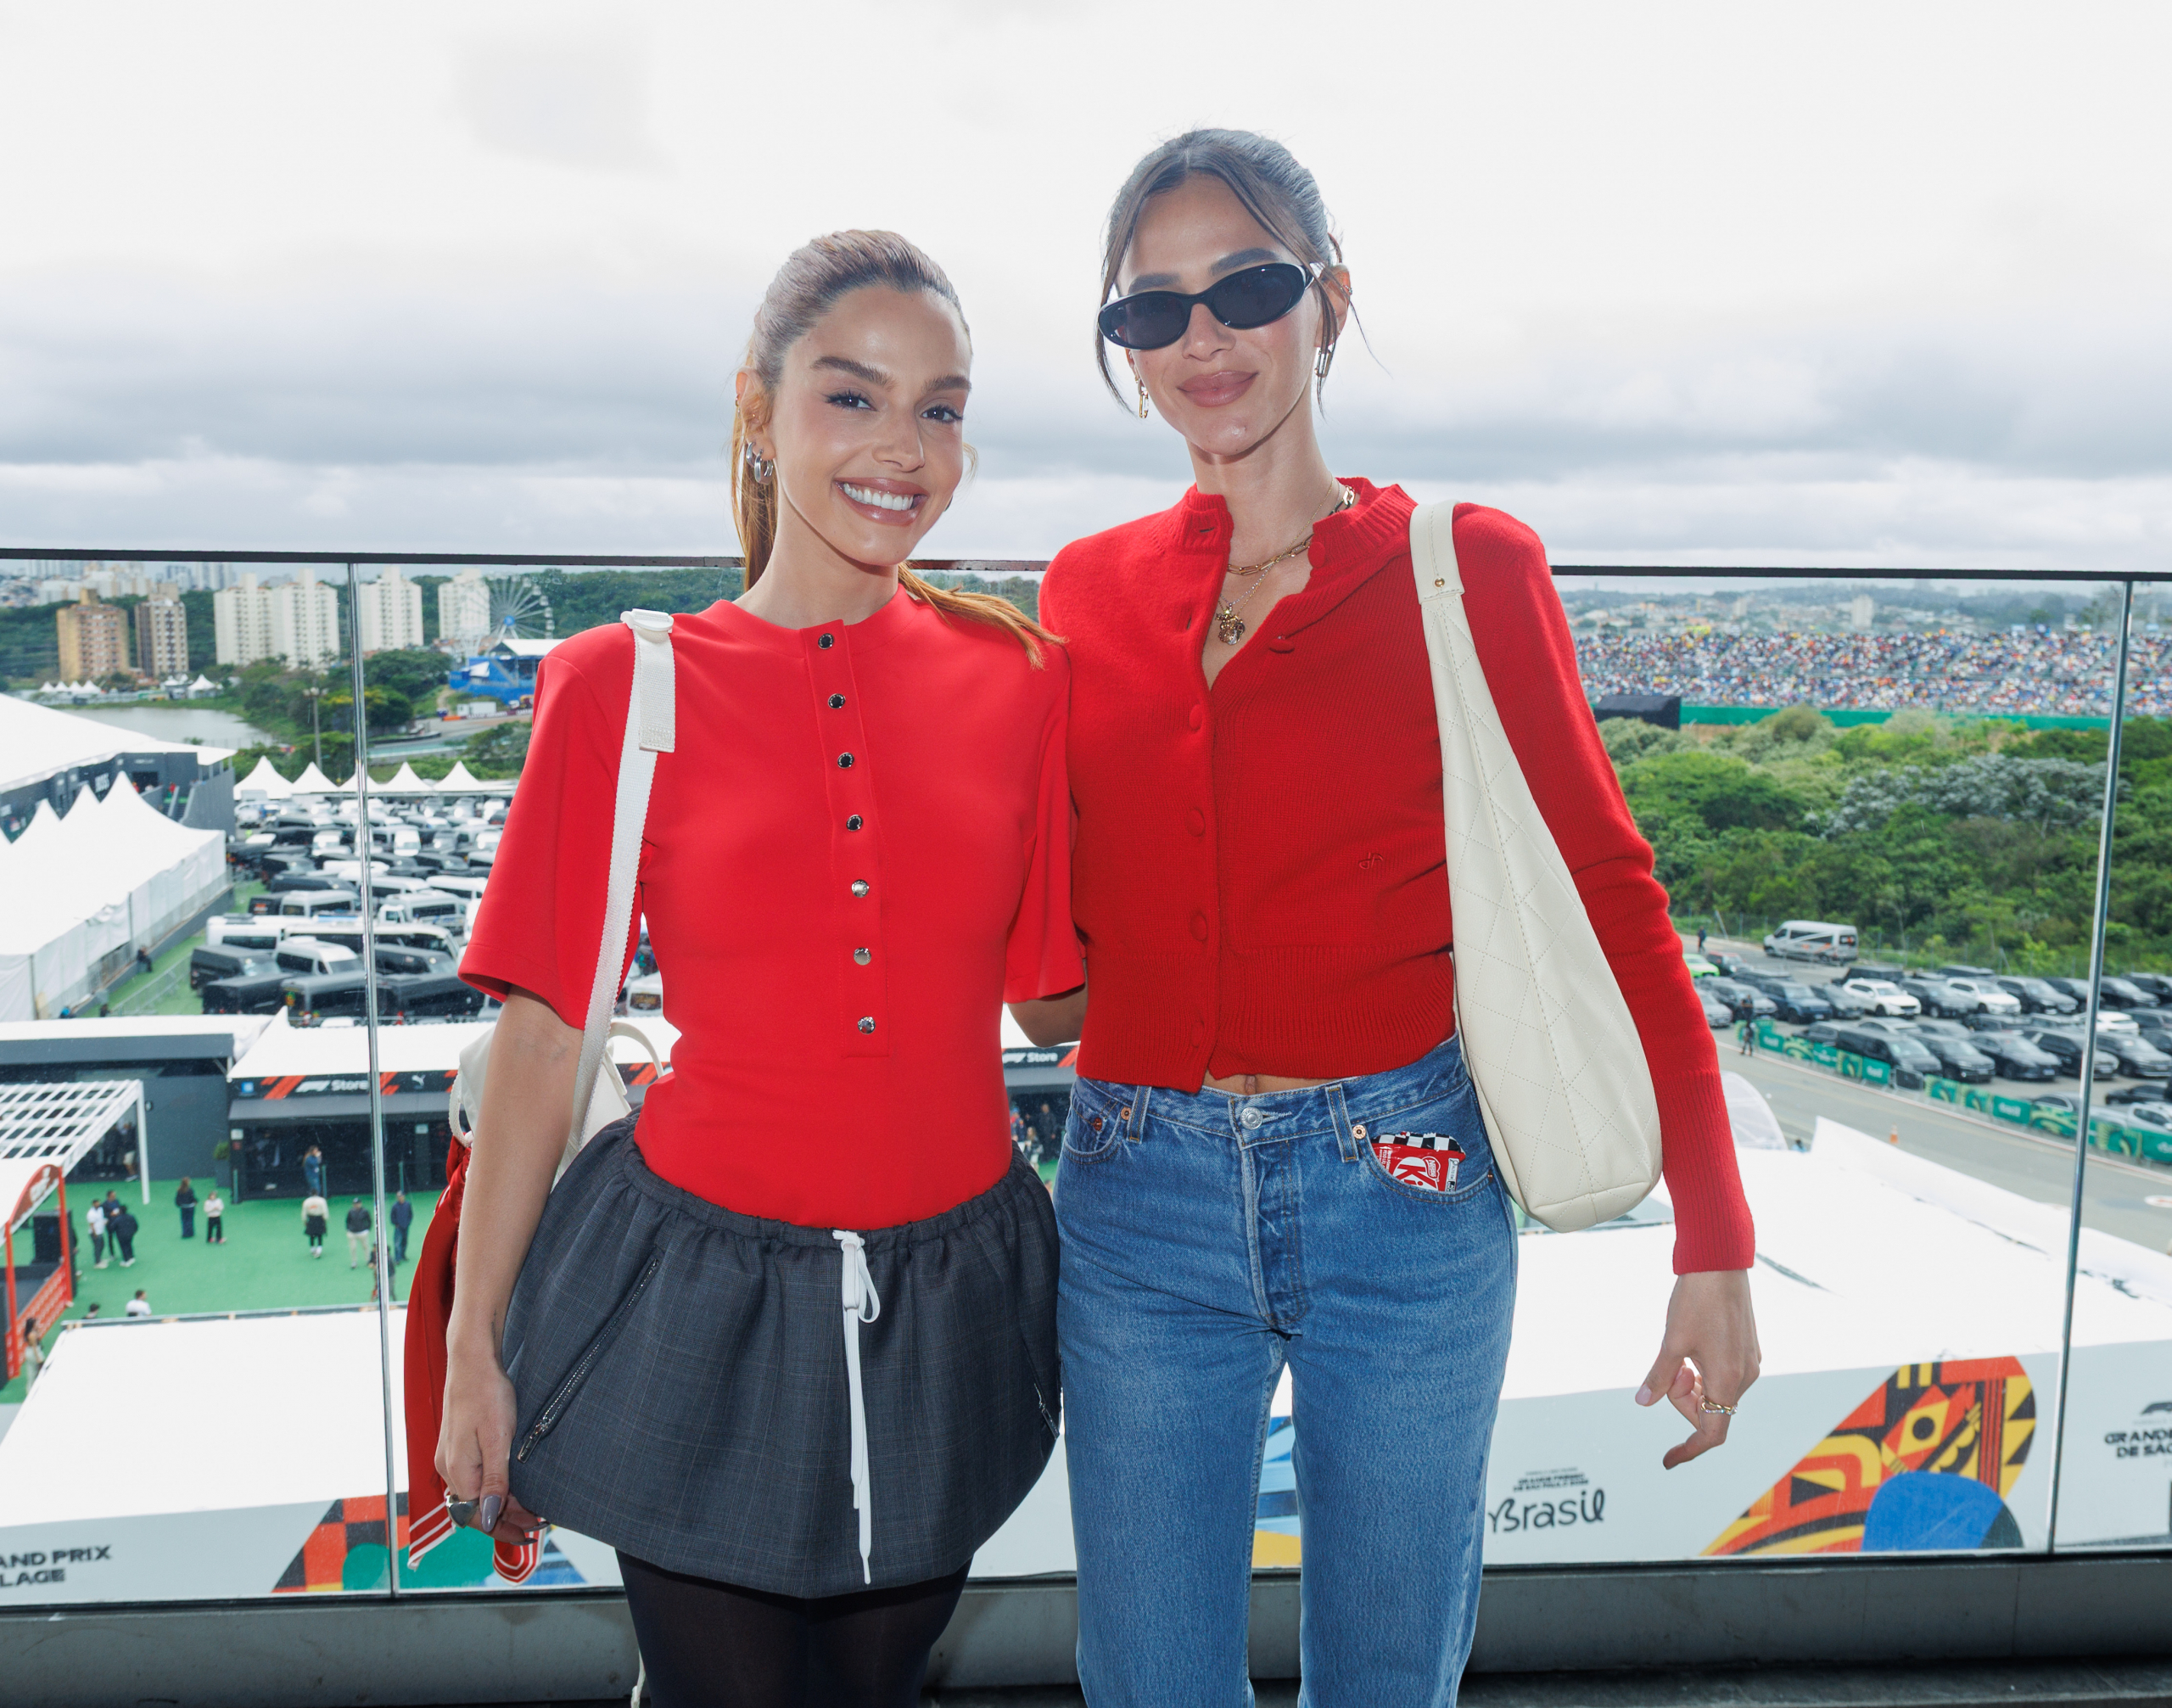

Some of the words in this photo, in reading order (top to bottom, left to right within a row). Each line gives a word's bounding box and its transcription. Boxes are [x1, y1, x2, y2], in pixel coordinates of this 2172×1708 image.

[1027, 1051, 1058, 1063] Store
[331, 1078, 369, 1091] Store
[2117, 1446, 2139, 1459] DE
[1487, 1488, 1605, 1533] Brasil
[52, 1544, 112, 1564] PRIX
[0, 1568, 65, 1588] LAGE
